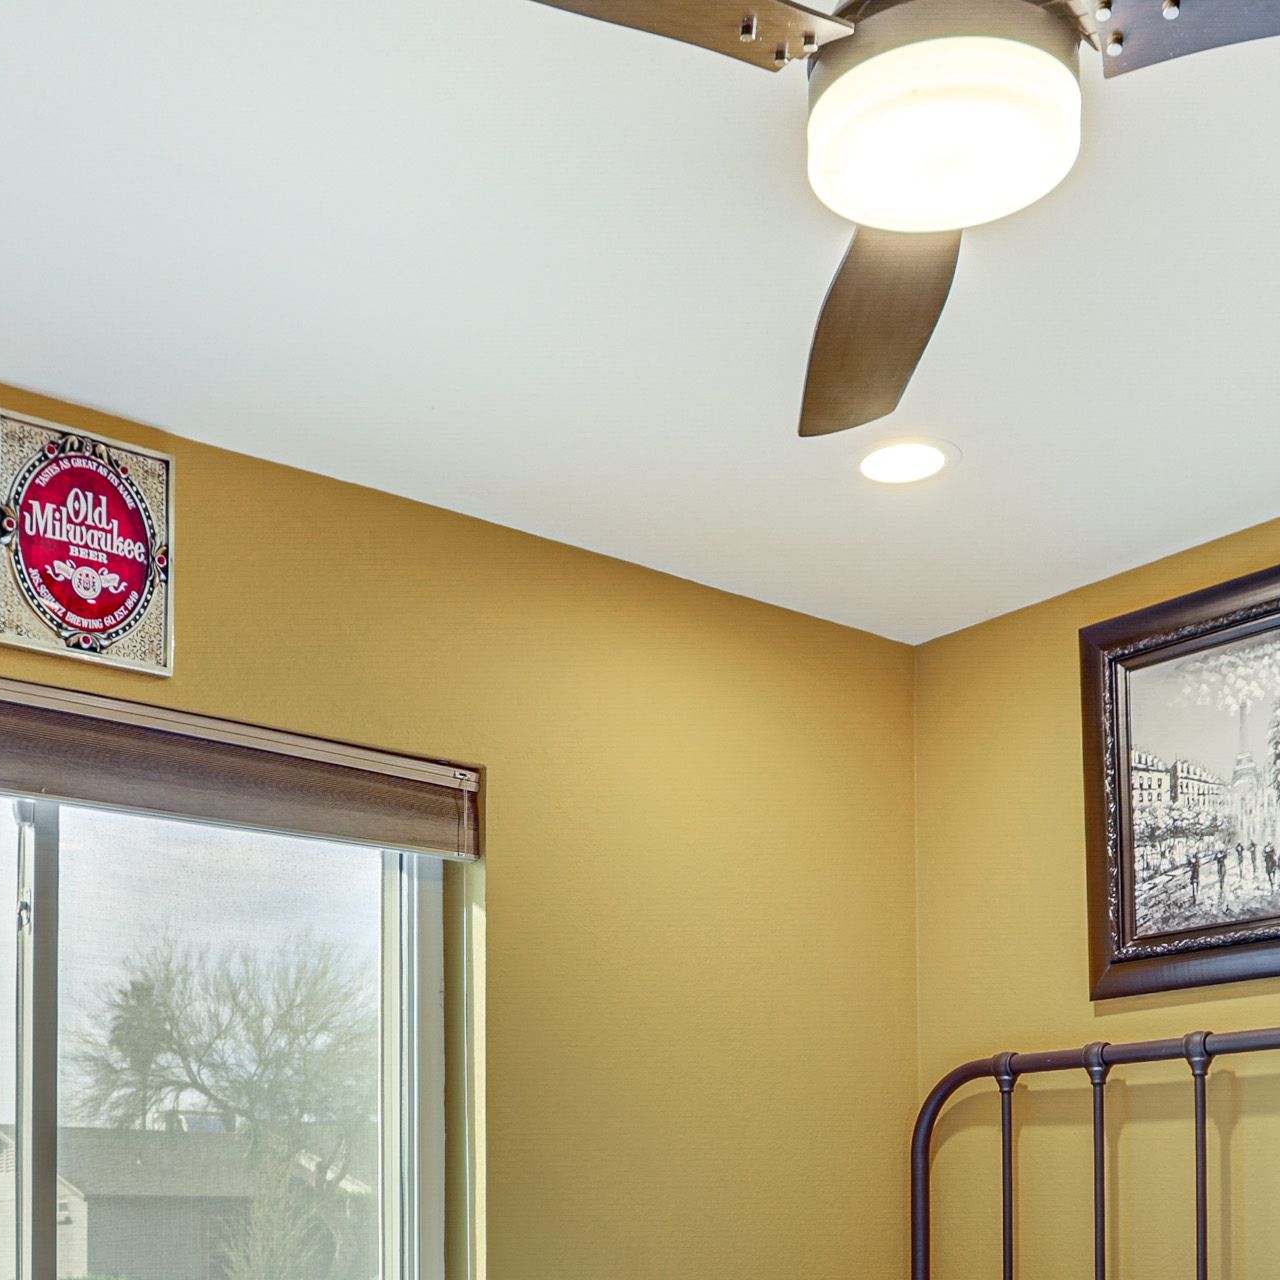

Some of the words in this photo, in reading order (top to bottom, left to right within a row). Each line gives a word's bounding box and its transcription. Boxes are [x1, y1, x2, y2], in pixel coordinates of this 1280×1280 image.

[35, 463, 60, 487] TASTES
[59, 458, 71, 470] AS
[71, 457, 99, 472] GREAT
[97, 465, 108, 476] AS
[107, 471, 119, 486] ITS
[117, 485, 136, 510] NAME
[66, 488, 112, 530] Old
[23, 499, 145, 562] Milwaukee
[69, 545, 108, 564] BEER
[65, 611, 104, 629] BREWING
[124, 590, 139, 610] 1849
